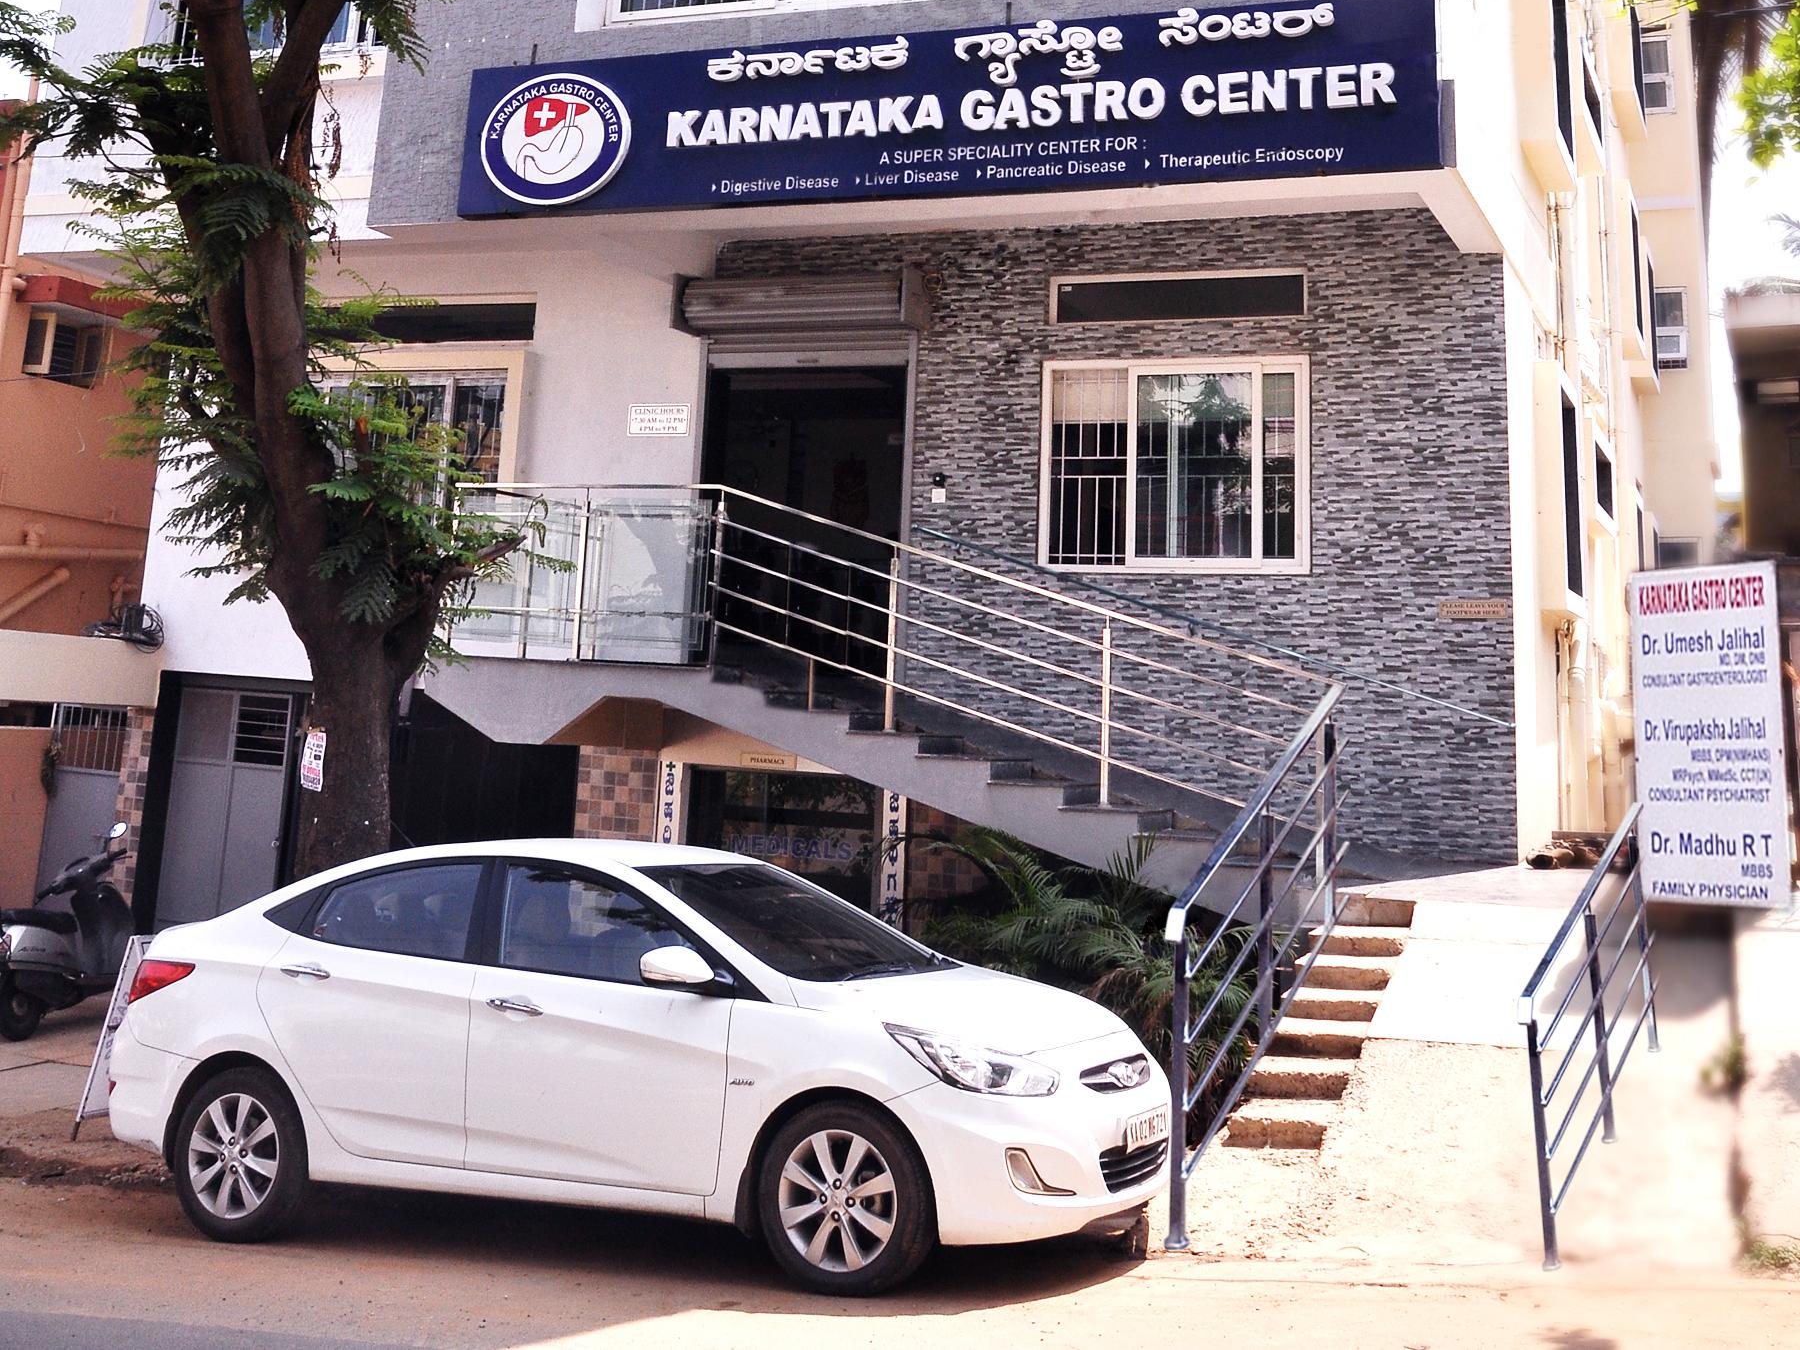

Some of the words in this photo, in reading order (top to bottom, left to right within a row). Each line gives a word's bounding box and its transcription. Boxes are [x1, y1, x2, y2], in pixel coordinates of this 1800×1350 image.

[707, 35, 909, 83] ಕರ್ನಾಟಕ
[1158, 2, 1335, 48] ಸೆಂಟರ್
[490, 85, 547, 139] KARNATAKA
[549, 83, 595, 101] GASTRO
[594, 96, 619, 143] CENTER
[666, 94, 944, 148] KARNATAKA
[959, 76, 1165, 134] GASTRO
[1180, 62, 1398, 117] CENTER
[879, 152, 890, 164] A
[894, 149, 943, 164] SUPER
[947, 142, 1034, 160] SPECIALITY
[1038, 138, 1100, 155] CENTER
[1105, 136, 1137, 151] FOR
[721, 179, 781, 195] Digestive
[786, 176, 839, 190] Disease
[865, 173, 900, 186] Liver
[904, 170, 960, 184] Disease
[987, 162, 1063, 179] Pancreatic
[1068, 159, 1126, 175] Disease
[1160, 150, 1250, 168] Therapeutic
[1256, 147, 1344, 162] Endoscopy
[1639, 581, 1690, 615] KARNATAKA
[1692, 579, 1727, 611] GASTRO
[1729, 576, 1765, 608] CENTER
[1642, 634, 1660, 655] Dr.
[1665, 630, 1713, 655] Umesh
[1718, 626, 1765, 651] Jalihal
[1642, 673, 1685, 688] CONSULTANT
[1687, 670, 1767, 686] GASTROENTEROLOGIST
[1645, 720, 1660, 741] Dr.
[1662, 718, 1725, 746] Virupaksha
[1728, 718, 1766, 740] Jalihal
[1648, 788, 1704, 802] CONSULTANT
[1707, 788, 1770, 802] PSYCHIATRIST
[730, 833, 853, 862] MEDICALS
[1651, 832, 1674, 855] Dr.
[1679, 832, 1737, 856] Madhu
[1742, 834, 1755, 857] R
[1760, 834, 1772, 858] T
[1741, 863, 1773, 878] MBBS
[1652, 881, 1695, 898] FAMILY
[1699, 882, 1769, 900] PHYSICIAN
